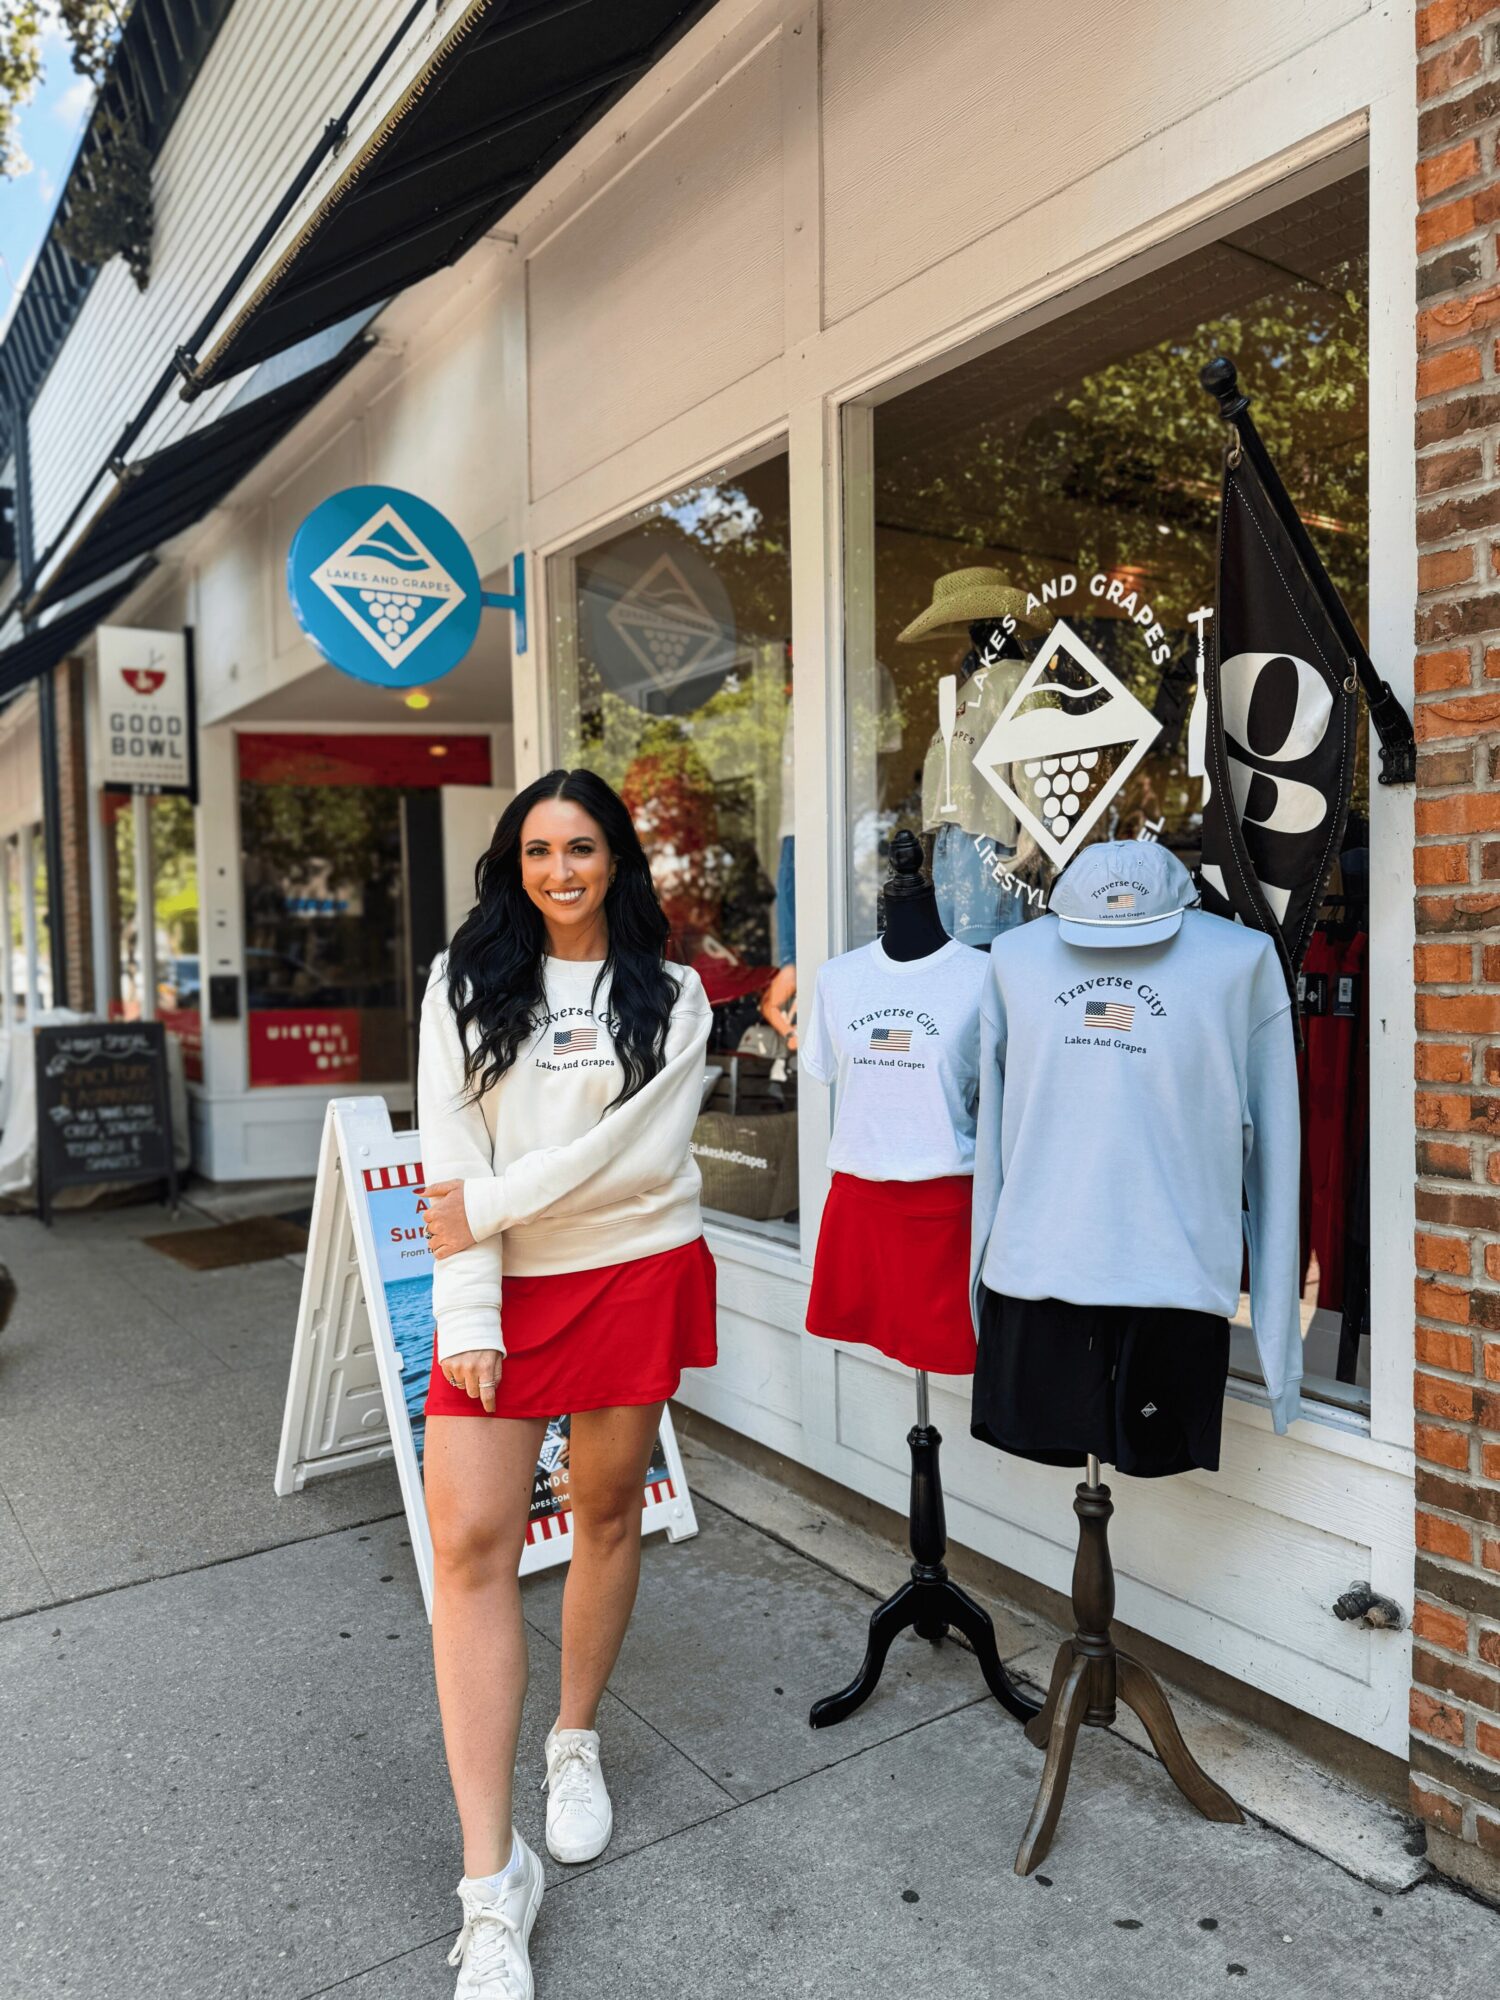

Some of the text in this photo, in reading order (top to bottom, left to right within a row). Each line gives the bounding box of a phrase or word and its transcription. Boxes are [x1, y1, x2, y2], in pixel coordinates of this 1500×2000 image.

[327, 569, 451, 592] LAKES AND GRAPES
[967, 573, 1171, 709] LAKES AND GRAPES
[110, 713, 181, 736] GOOD
[111, 737, 181, 759] BOWL
[974, 832, 1048, 910] LIFESTYL
[1091, 880, 1150, 900] Traverse City
[1054, 976, 1167, 1017] Traverse City
[848, 1008, 940, 1036] Traverse City
[1065, 1036, 1147, 1054] Lakes And Grapes
[535, 1058, 615, 1071] Lakes And Grapes
[853, 1057, 926, 1070] Lakes And Grapes
[401, 1248, 425, 1259] From
[530, 1493, 570, 1511] APES.COM
